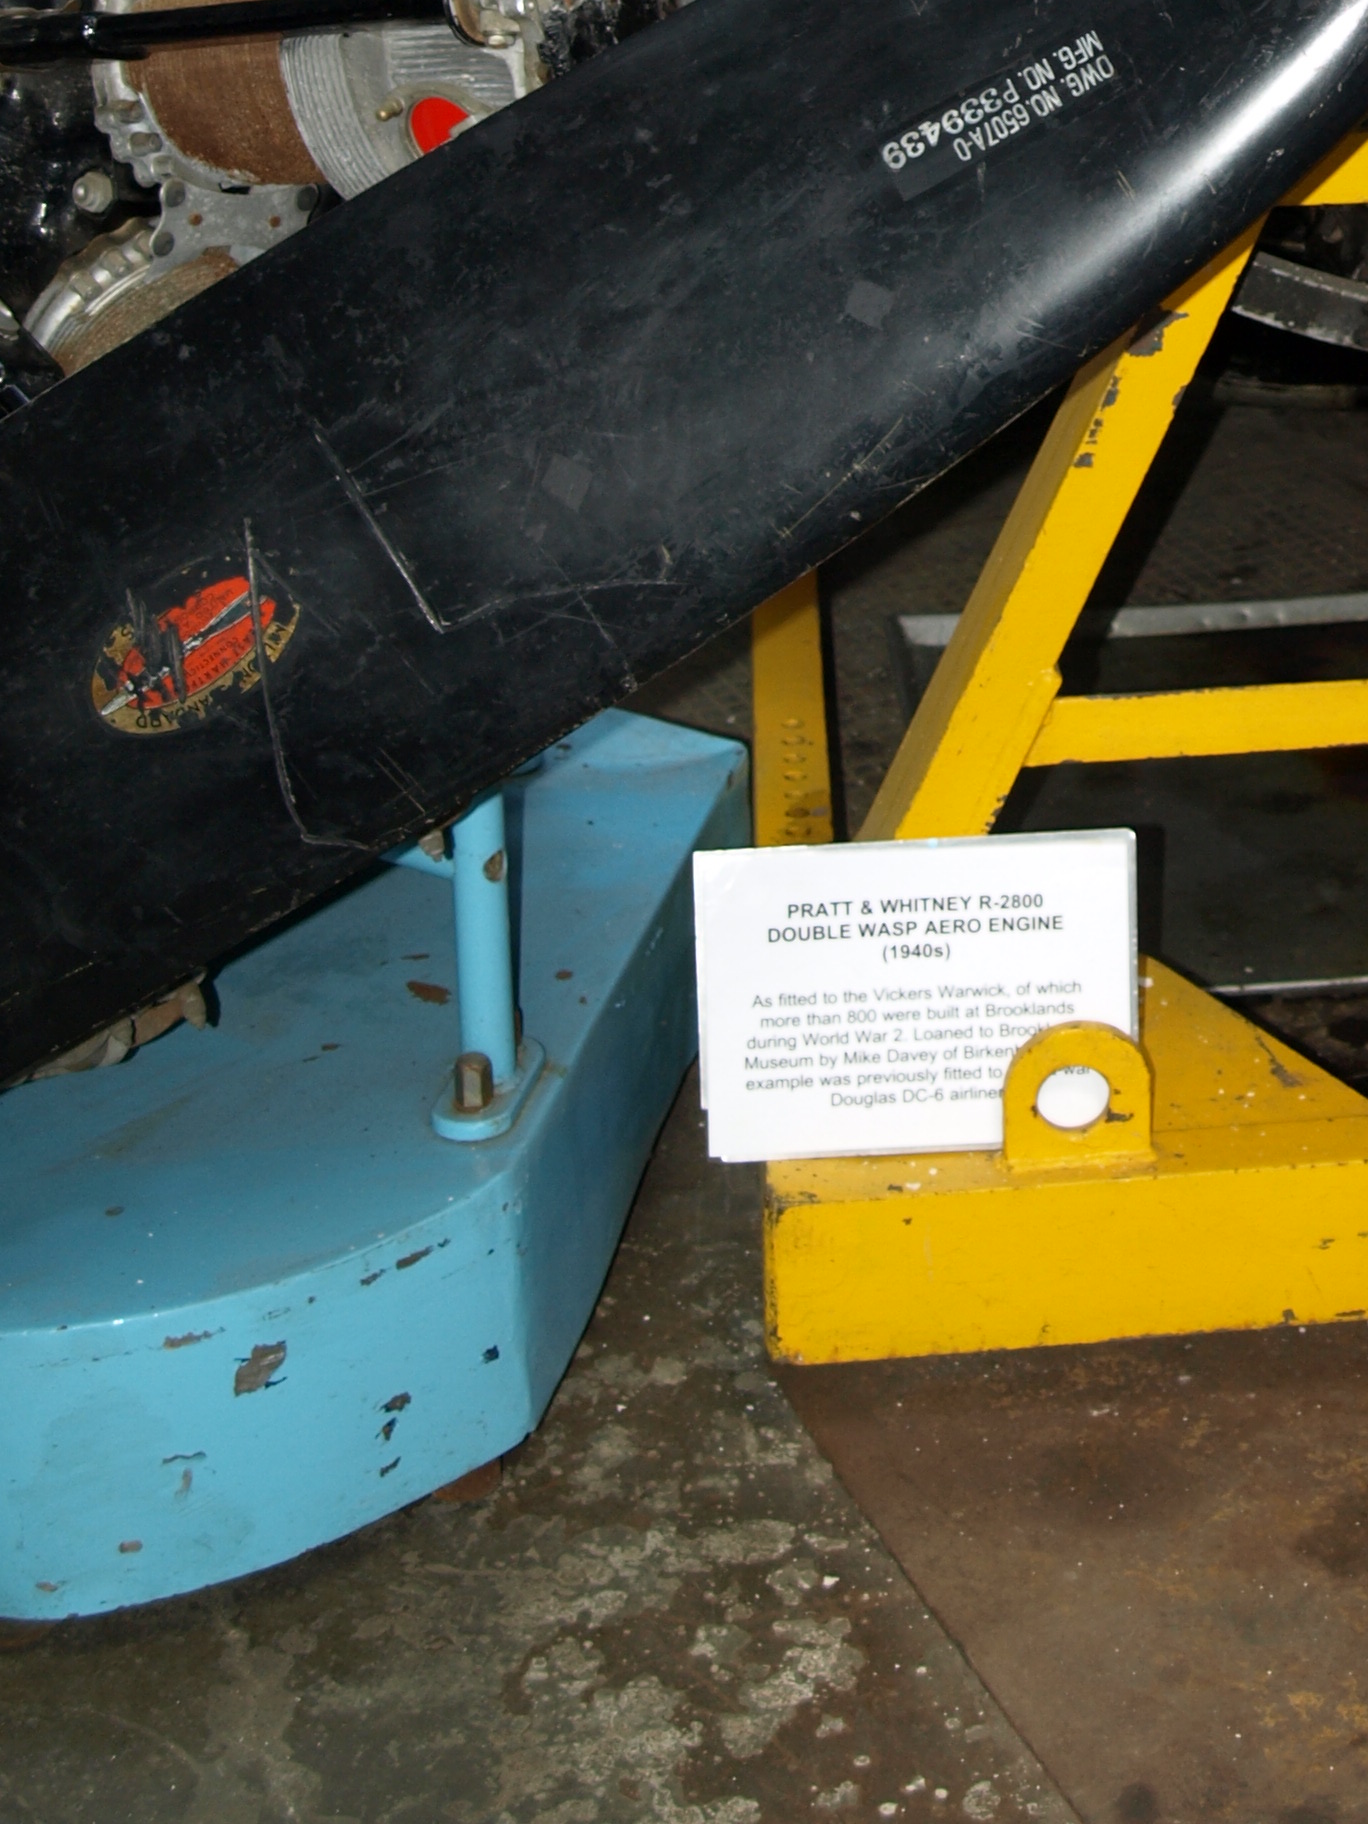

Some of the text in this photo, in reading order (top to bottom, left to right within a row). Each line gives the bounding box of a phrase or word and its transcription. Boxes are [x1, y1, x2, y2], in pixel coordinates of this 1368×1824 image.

[1052, 30, 1105, 72] MFG.
[1017, 57, 1056, 91] NO.
[1060, 54, 1115, 97] DWG.
[787, 894, 1043, 918] PRATT & WHITNEY R-2800
[767, 915, 1063, 943] DOUBLE WASP AERO ENGINE
[882, 944, 951, 961] (1940s)
[751, 981, 1082, 1008] As fitted to the Vickers Warwick, of which
[760, 1003, 1075, 1028] more than 800 were built at Brooklands
[746, 1037, 797, 1051] during
[802, 1032, 850, 1046] World
[854, 1030, 888, 1043] War
[893, 1028, 907, 1042] 2.
[913, 1027, 974, 1041] Loaned
[979, 1026, 994, 1038] to
[744, 1056, 814, 1069] Museum
[819, 1054, 838, 1069] by
[843, 1051, 881, 1064] Mike
[887, 1049, 937, 1063] Davey
[943, 1046, 958, 1060] of
[745, 1067, 1005, 1091] example was previously fitted to
[830, 1092, 897, 1108] Douglas
[902, 1088, 944, 1103] DC-6
